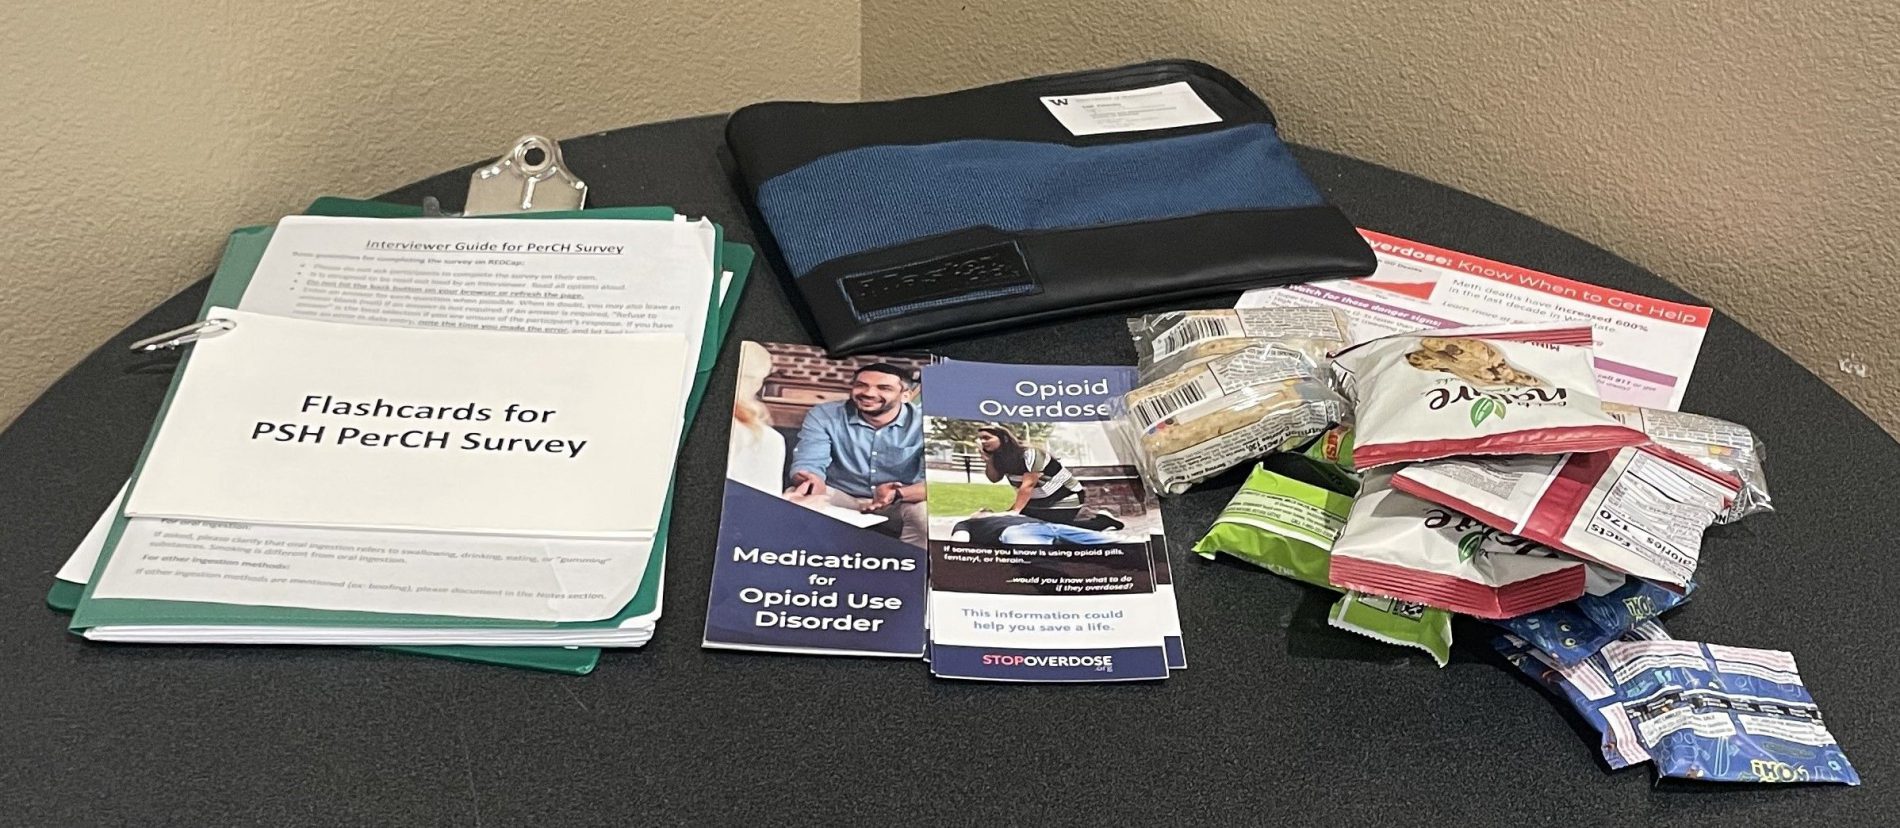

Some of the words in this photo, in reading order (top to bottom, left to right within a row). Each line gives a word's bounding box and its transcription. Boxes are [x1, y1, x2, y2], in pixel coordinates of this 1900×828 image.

[1051, 98, 1068, 106] W
[366, 240, 451, 250] Interviewer
[455, 241, 497, 251] Guide
[502, 242, 524, 251] for
[527, 242, 571, 252] PerCH
[575, 243, 624, 255] Survey
[1369, 239, 1453, 266] verdose:
[1458, 260, 1513, 280] Know
[1519, 273, 1577, 297] When
[1583, 290, 1602, 303] to
[1608, 297, 1645, 313] Get
[1649, 306, 1697, 324] Help
[1322, 291, 1340, 302] for
[1341, 295, 1369, 308] these
[1371, 304, 1410, 319] danger
[1411, 314, 1442, 328] signs:
[1442, 300, 1470, 311] Learn
[1472, 308, 1498, 319] more
[1448, 287, 1460, 295] in
[1462, 290, 1481, 298] the
[1484, 295, 1503, 304] last
[1507, 301, 1547, 316] decade
[1550, 311, 1561, 320] in
[1594, 323, 1616, 333] tate
[1452, 280, 1482, 291] Meth
[1485, 287, 1522, 301] deaths
[1525, 297, 1552, 308] have
[1555, 305, 1612, 323] increased
[1615, 319, 1649, 333] 600%
[1598, 374, 1613, 383] call
[1015, 378, 1109, 400] Opioid
[301, 395, 492, 421] Flashcards
[504, 404, 557, 423] for
[979, 400, 1109, 417] Overdose
[251, 422, 325, 443] PSH
[337, 427, 450, 449] PerCH
[461, 432, 587, 458] Survey
[202, 521, 250, 529] ingestion:
[1600, 510, 1630, 532] 170
[1591, 523, 1631, 548] Facts
[210, 544, 252, 554] Smoking
[263, 548, 308, 557] different
[231, 537, 263, 545] clarify
[309, 543, 355, 551] ingestion
[401, 549, 458, 559] swallowing,
[460, 551, 503, 561] drinking,
[505, 554, 539, 564] eating,
[556, 556, 612, 565] "gumming"
[733, 546, 916, 572] Medications
[944, 555, 981, 564] fentanyl,
[995, 556, 1032, 565] heroin...
[952, 547, 992, 555] someone
[994, 548, 1011, 556] you
[1048, 549, 1072, 558] using
[1074, 548, 1103, 557] opioid
[1104, 548, 1125, 557] pills,
[1646, 536, 1697, 568] alories
[192, 557, 239, 565] ingestion
[241, 561, 290, 569] methods:
[174, 570, 221, 578] ingestion
[223, 573, 268, 582] methods
[289, 578, 345, 587] mentioned
[368, 583, 412, 593] boofing),
[451, 587, 503, 595] document
[808, 574, 836, 586] for
[1006, 576, 1039, 584] ...would
[1041, 577, 1057, 585] you
[1059, 576, 1084, 584] know
[1085, 576, 1107, 584] what
[1120, 575, 1133, 583] do
[1063, 585, 1084, 593] they
[1085, 583, 1134, 592] overdosed?
[739, 588, 838, 608] Opioid
[848, 593, 903, 609] Use
[755, 611, 884, 632] Disorder
[962, 607, 991, 618] This
[995, 609, 1080, 620] information
[1084, 609, 1124, 619] could
[973, 621, 1004, 632] help
[1009, 623, 1035, 632] you
[1040, 623, 1071, 632] save
[1088, 621, 1115, 632] life.
[983, 654, 1113, 666] STOPOVERDOSE
